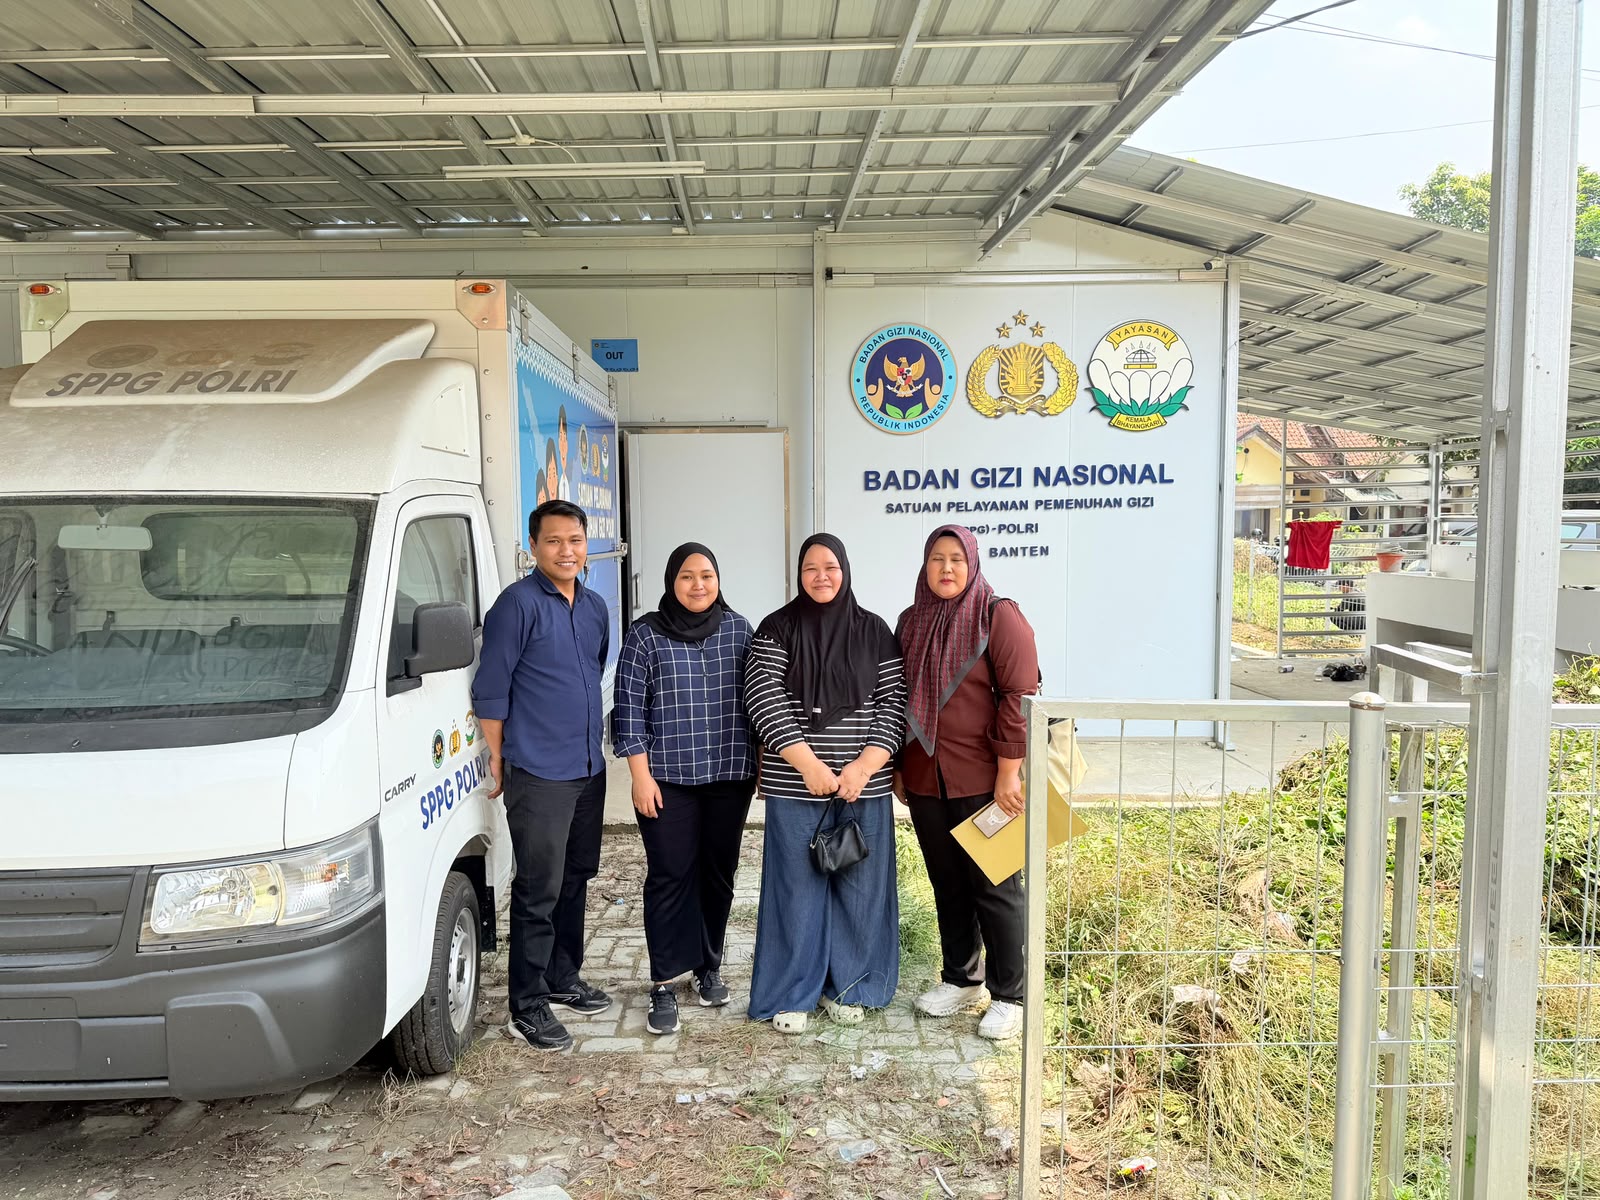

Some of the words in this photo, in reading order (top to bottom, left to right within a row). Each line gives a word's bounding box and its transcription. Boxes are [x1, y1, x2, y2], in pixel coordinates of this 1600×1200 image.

[859, 333, 886, 364] BADAN
[886, 327, 906, 338] GIZI
[908, 327, 949, 361] NASIONAL
[1115, 325, 1169, 339] YAYASAN
[605, 351, 624, 360] OUT
[45, 371, 164, 397] SPPG
[166, 369, 298, 394] POLRI
[860, 396, 901, 429] REPUBLIK
[904, 394, 949, 430] INDONESIA
[1116, 420, 1161, 429] BHAYANGKARI
[863, 469, 960, 491] BADAN
[970, 466, 1022, 488] GIZI
[1033, 463, 1174, 487] NASIONAL
[885, 502, 942, 514] SATUAN
[947, 499, 1029, 512] PELAYANAN
[1035, 496, 1122, 511] PEMENUHAN
[1127, 496, 1154, 508] GIZI
[989, 545, 1050, 558] BANTEN
[384, 772, 417, 803] CARRY
[420, 778, 454, 830] SPPG
[455, 753, 487, 801] POLRI
